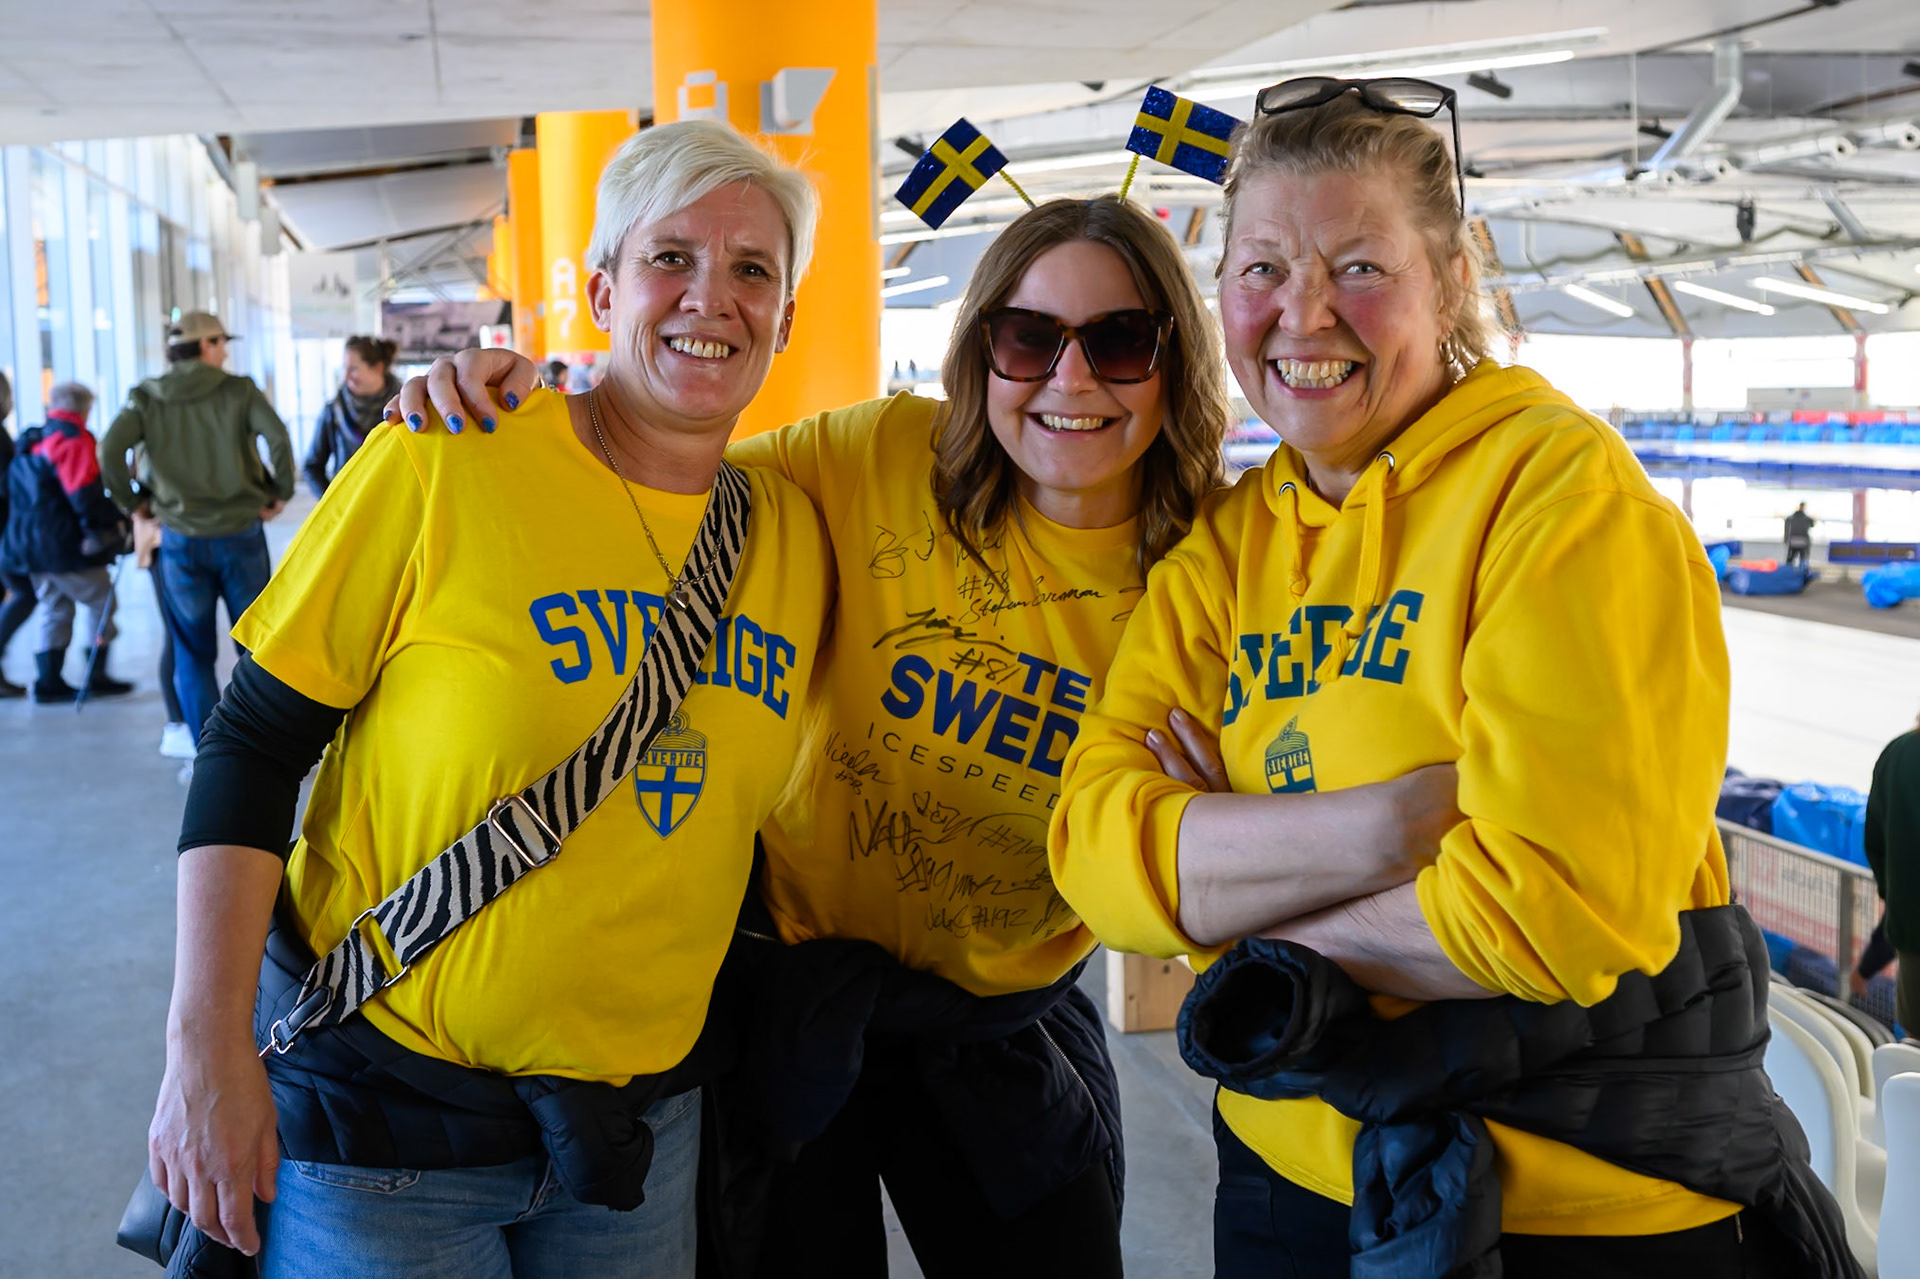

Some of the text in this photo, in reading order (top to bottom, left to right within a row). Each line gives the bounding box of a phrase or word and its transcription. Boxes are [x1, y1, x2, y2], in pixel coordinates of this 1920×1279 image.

[528, 589, 797, 720] SVEIGE
[880, 653, 1080, 778] SWED
[640, 750, 704, 767] SVERIGE
